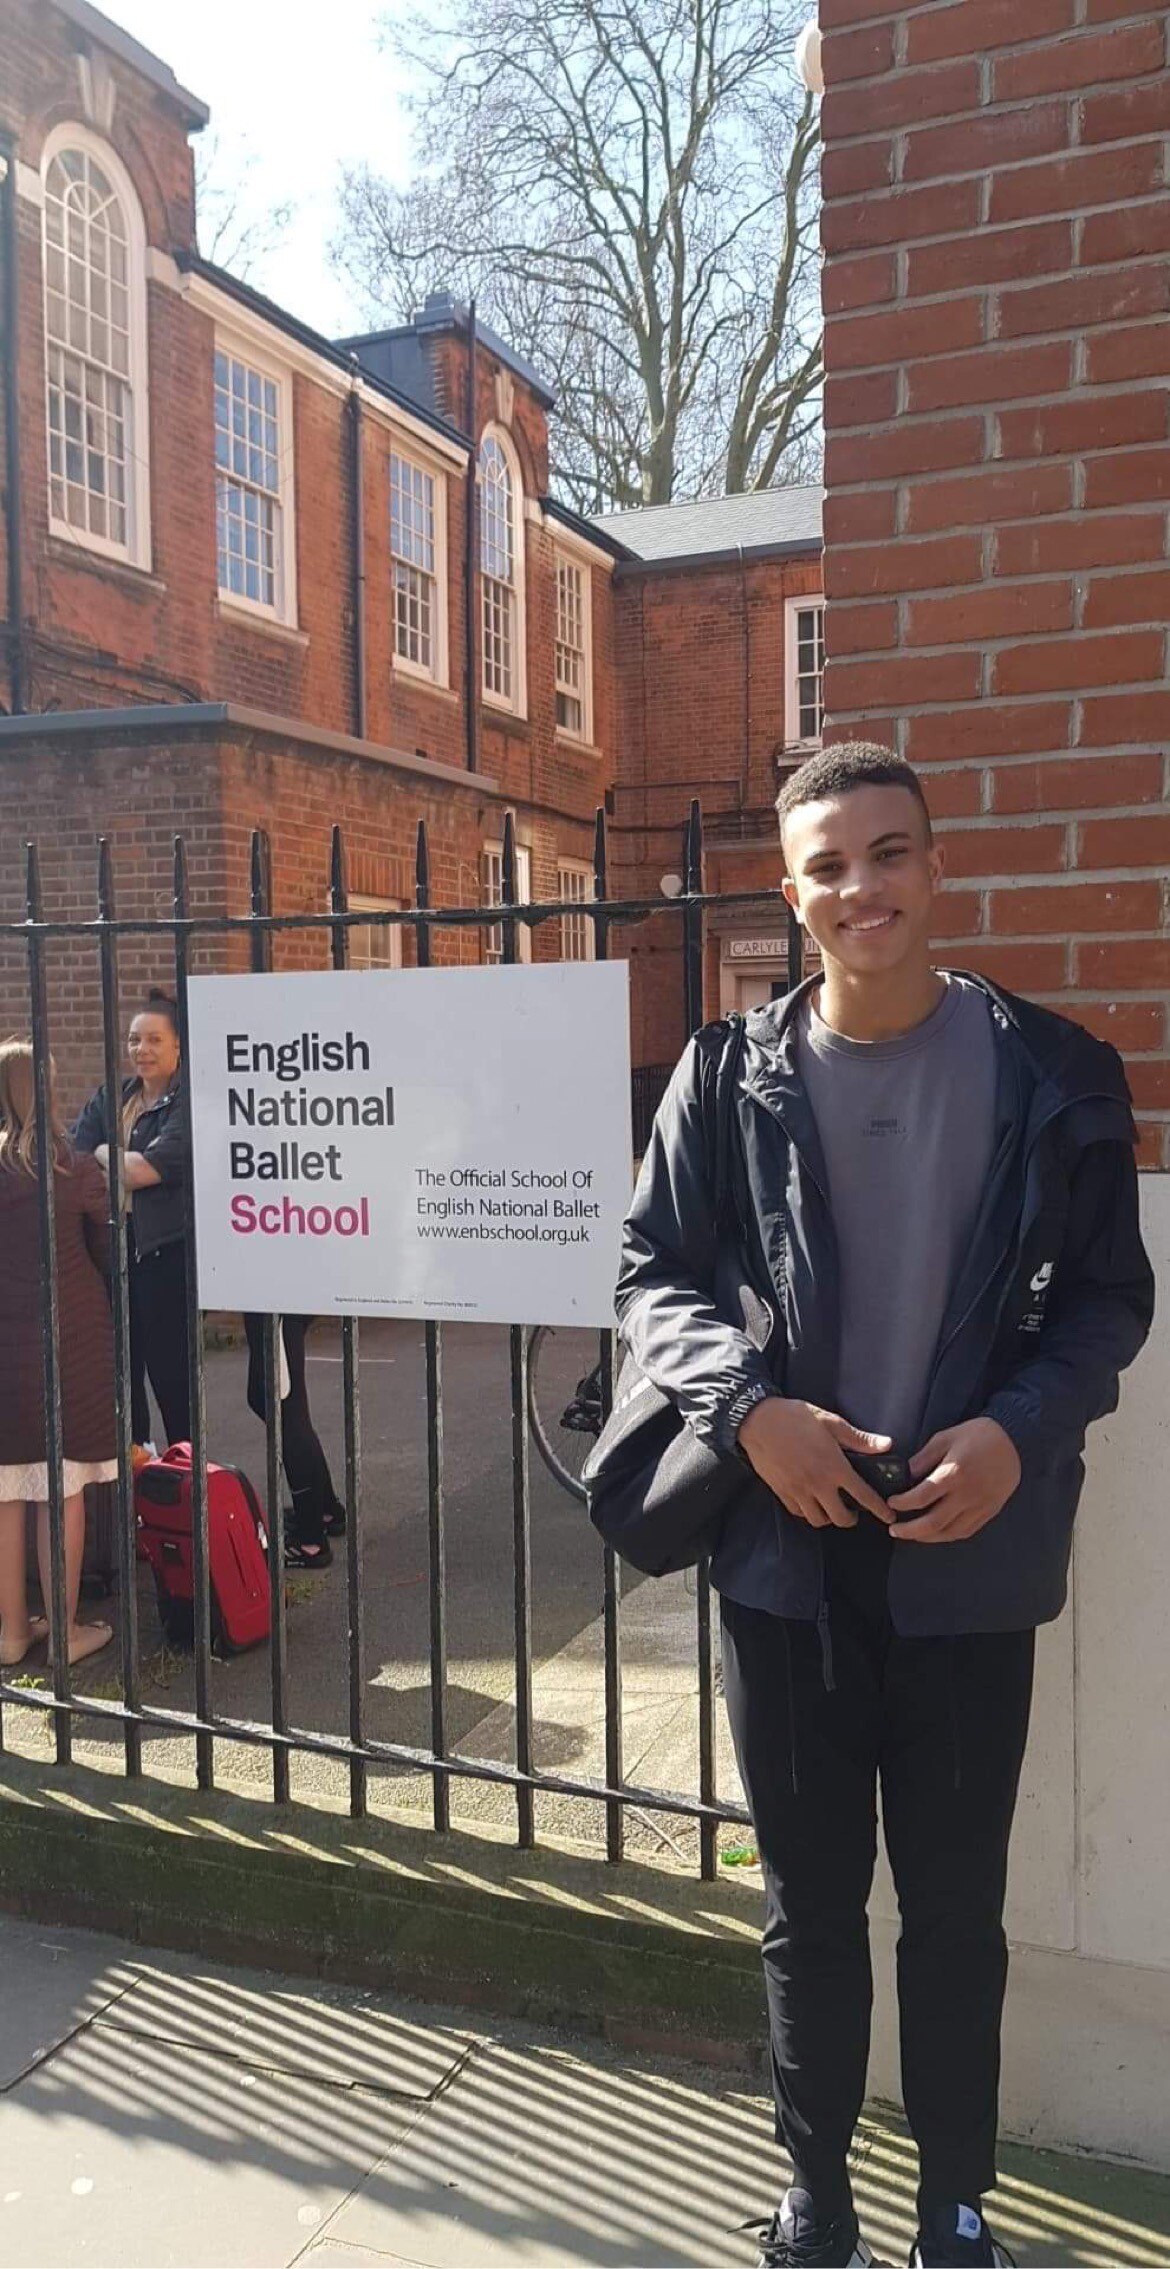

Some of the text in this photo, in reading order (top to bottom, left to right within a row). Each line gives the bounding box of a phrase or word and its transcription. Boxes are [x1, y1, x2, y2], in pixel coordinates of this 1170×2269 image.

[733, 941, 787, 954] CARLYLE
[226, 1032, 370, 1082] English
[228, 1087, 394, 1126] National
[230, 1142, 342, 1180] Ballet
[415, 1169, 594, 1188] The Official School Of
[231, 1195, 370, 1236] School
[417, 1198, 601, 1219] English National Ballet
[417, 1223, 590, 1246] www.enbschool.org.uk
